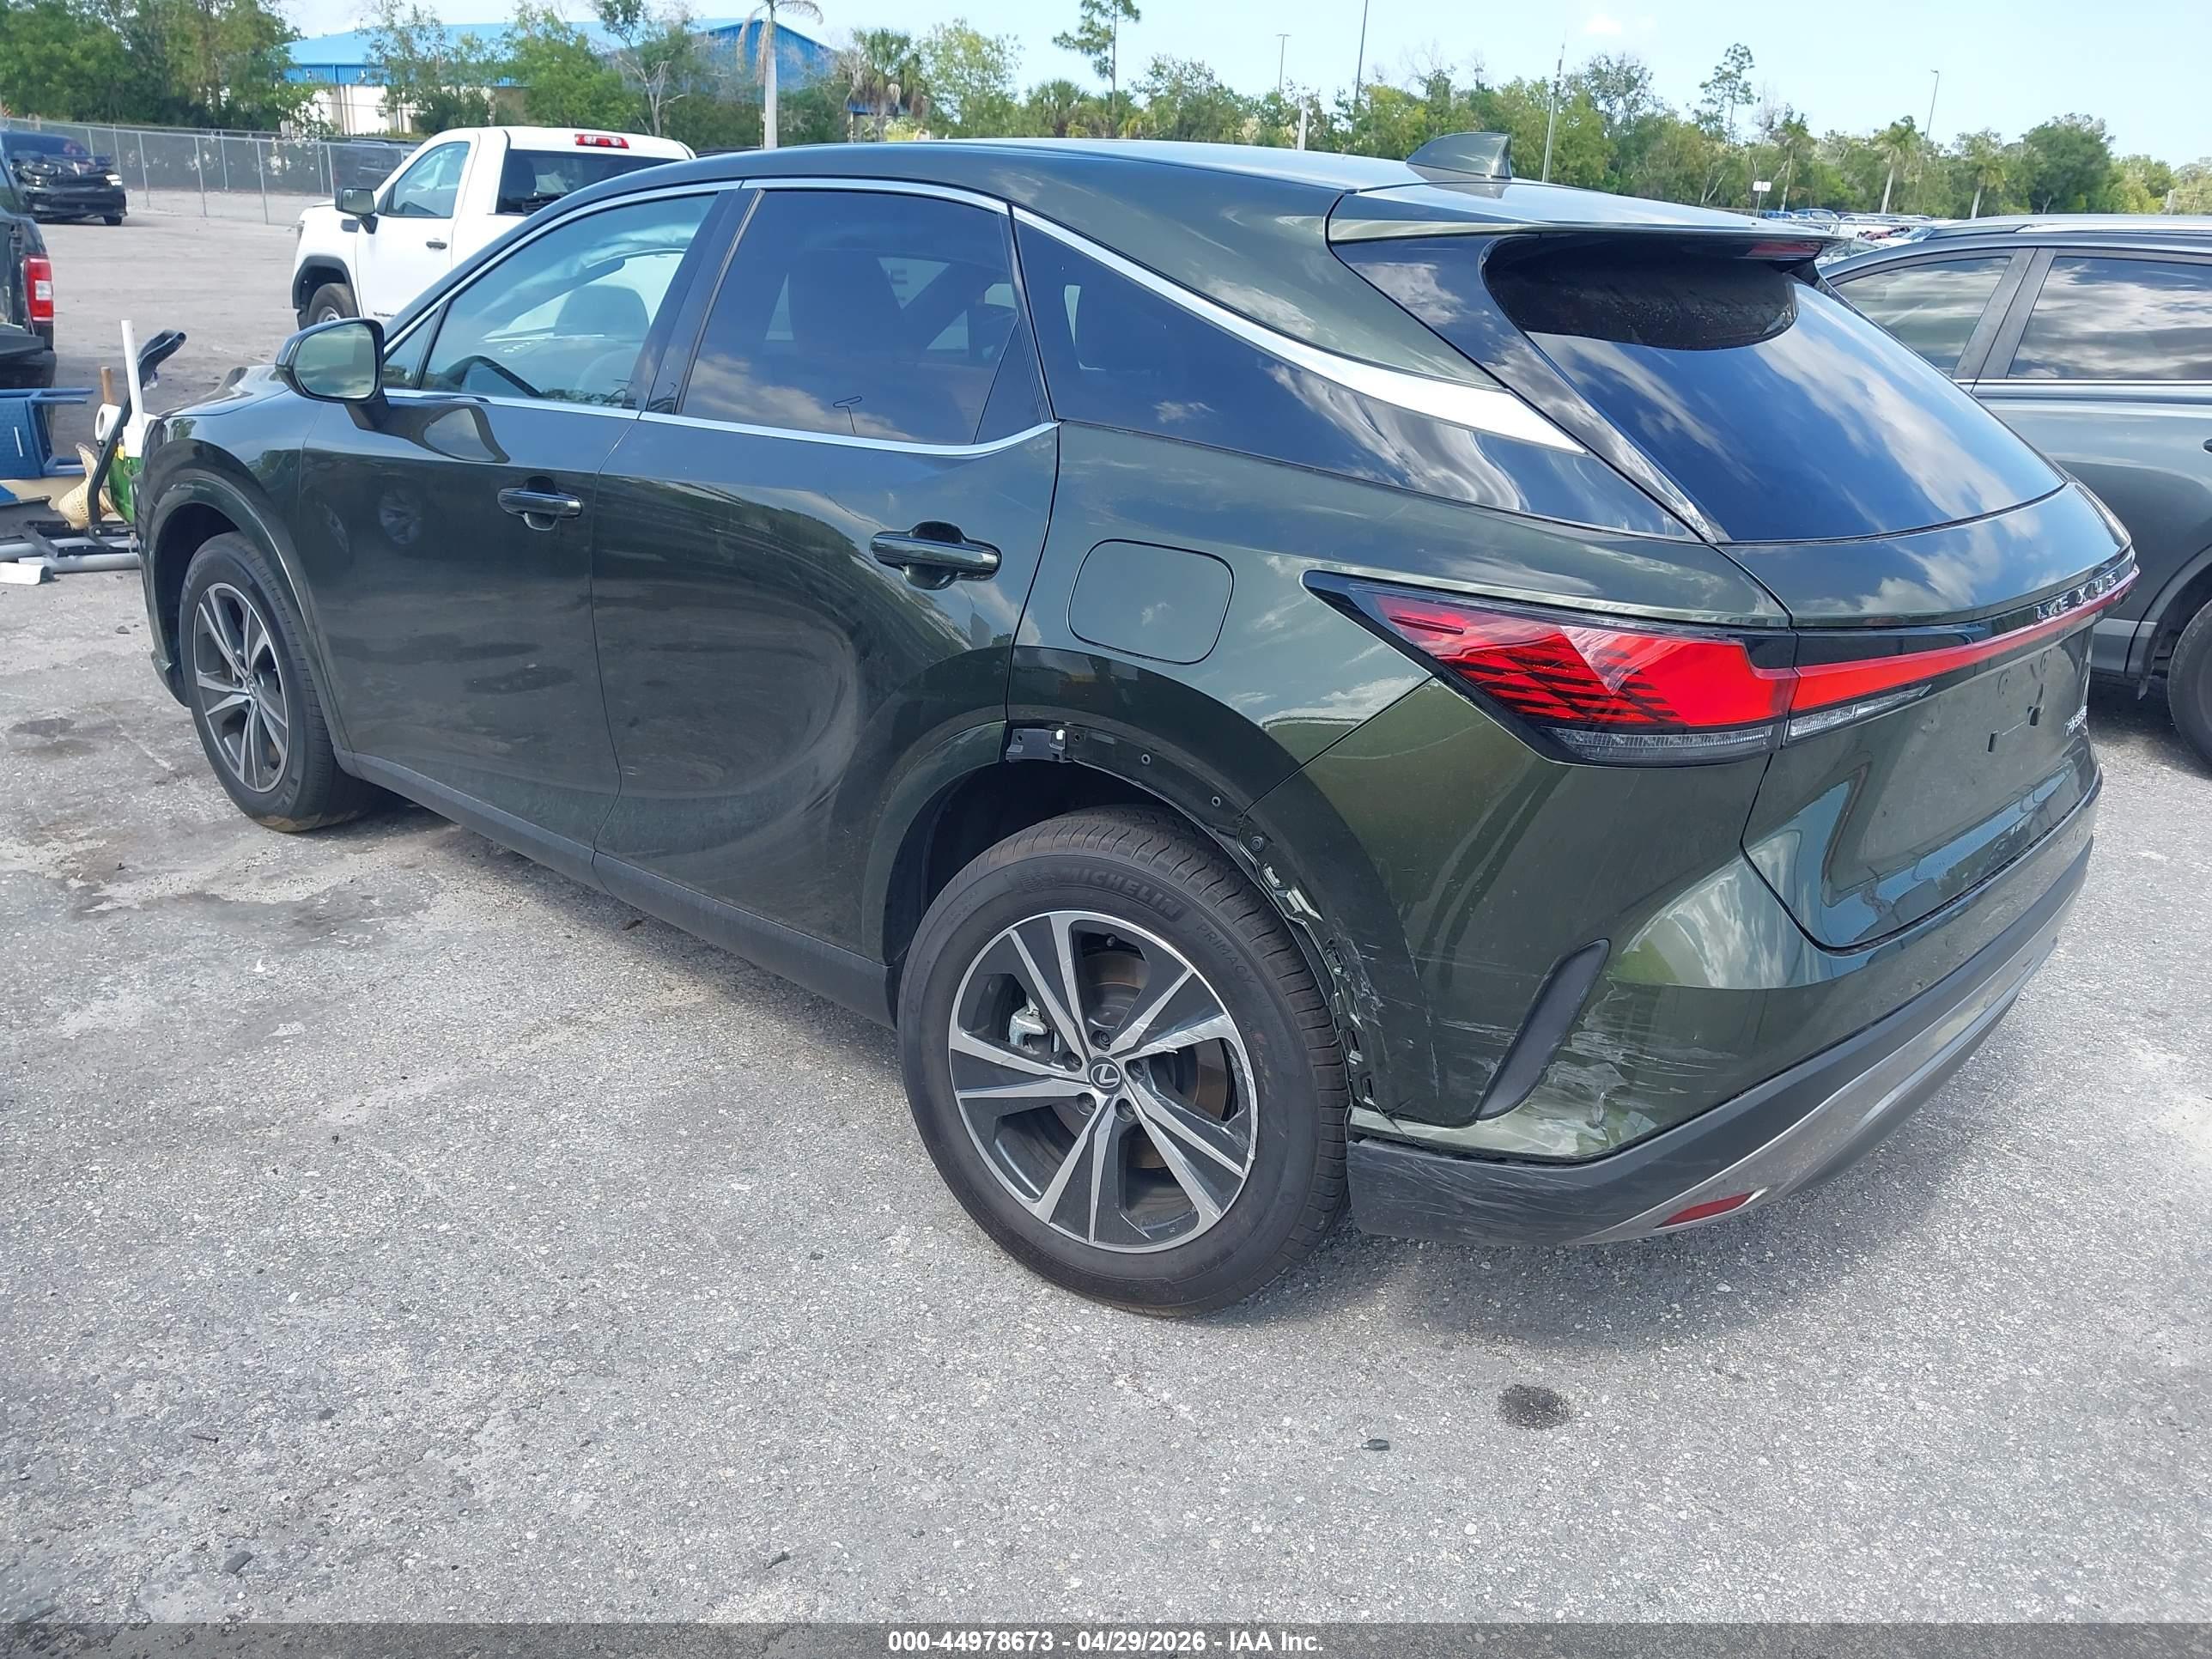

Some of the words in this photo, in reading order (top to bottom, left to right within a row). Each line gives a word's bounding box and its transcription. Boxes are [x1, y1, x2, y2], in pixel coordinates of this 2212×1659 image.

[2034, 571, 2117, 620] LEXUS
[1057, 867, 1182, 921] MICHELIN
[1195, 923, 1257, 984] PRIMACY
